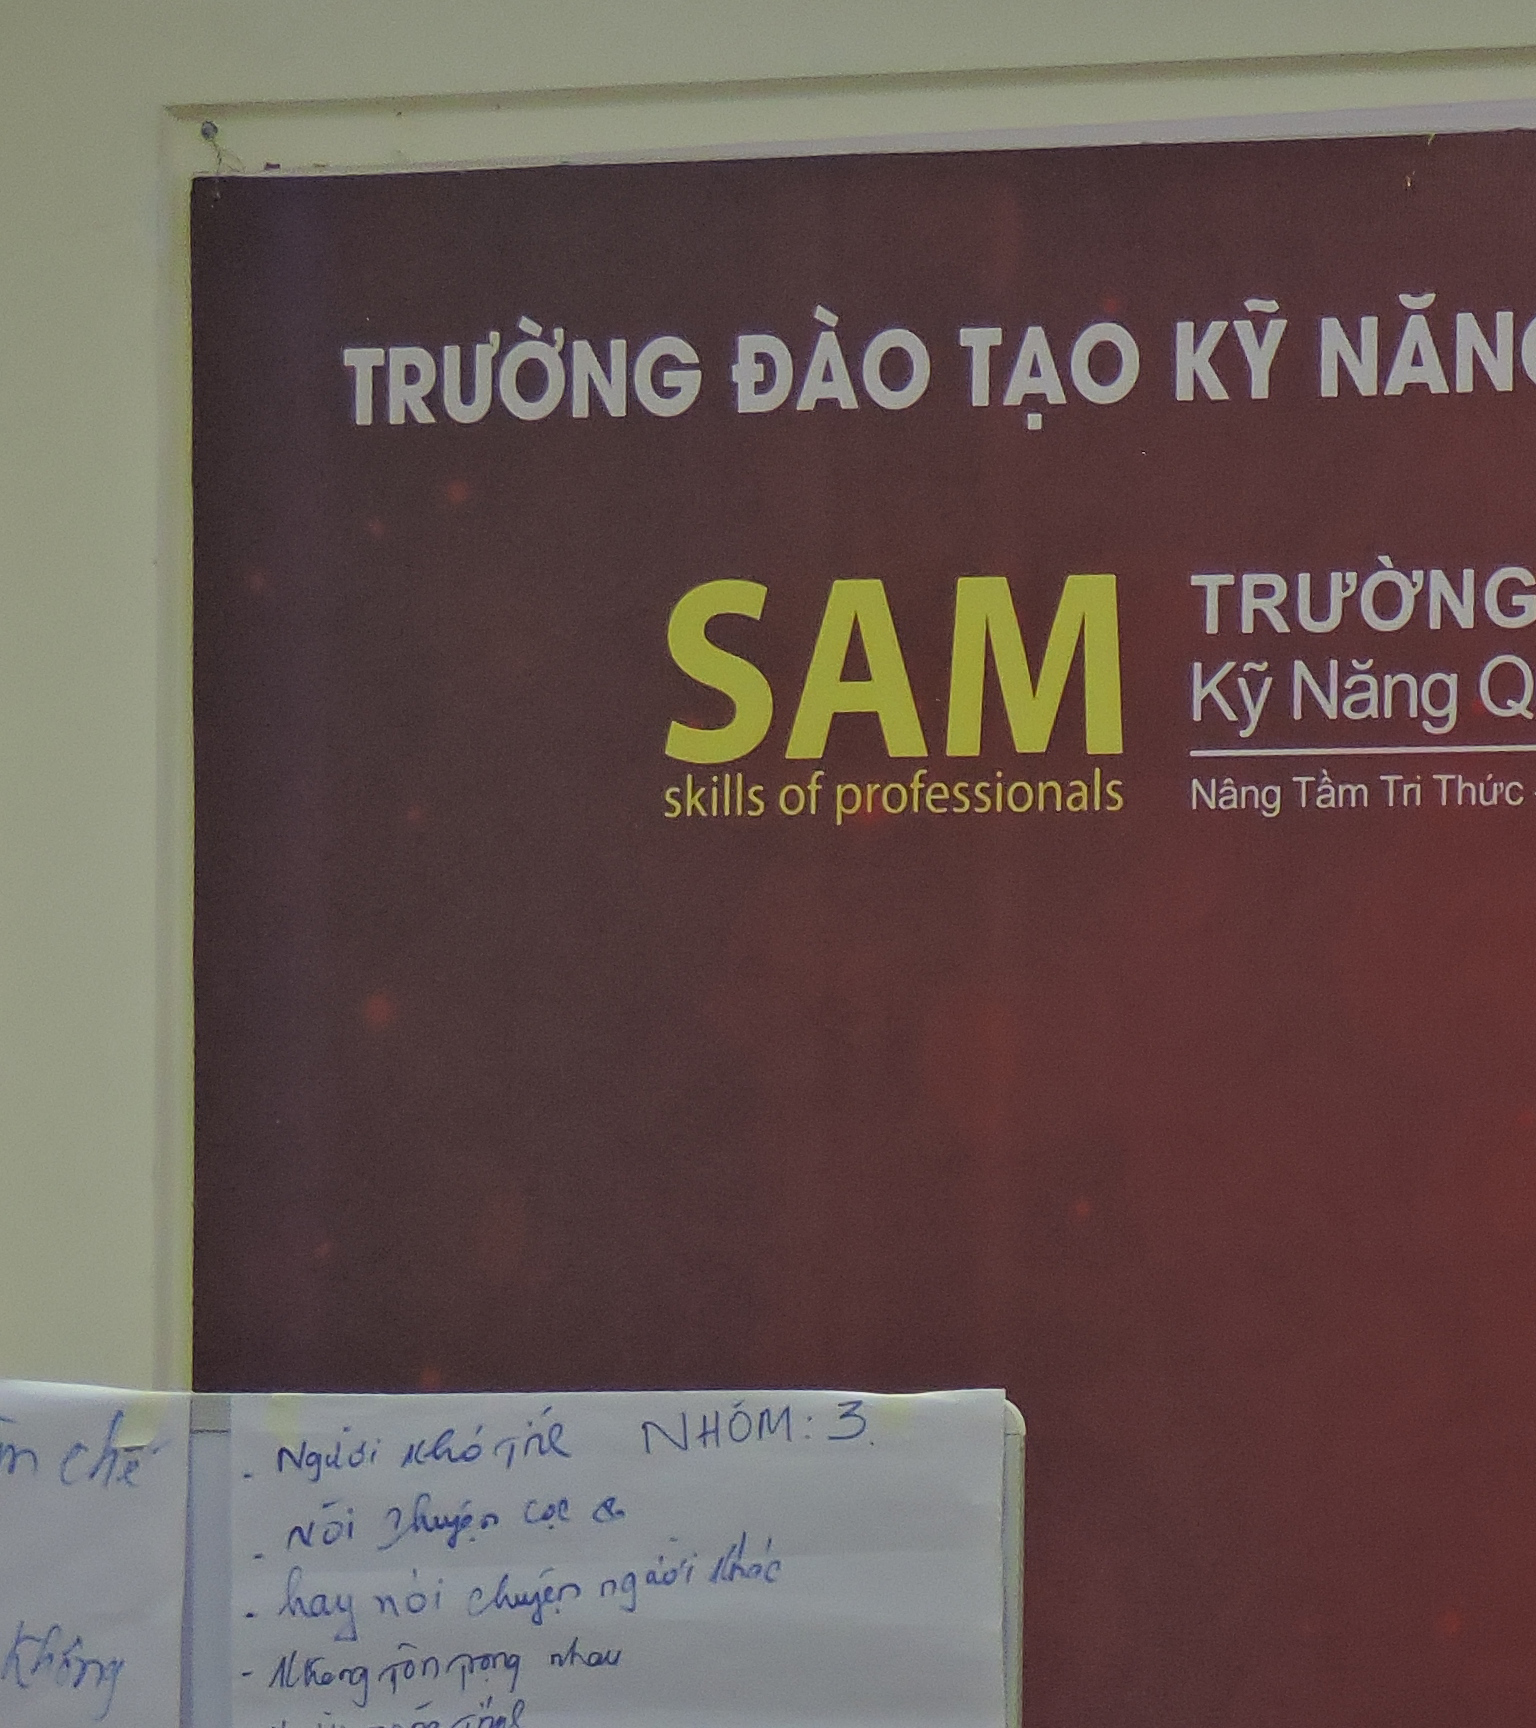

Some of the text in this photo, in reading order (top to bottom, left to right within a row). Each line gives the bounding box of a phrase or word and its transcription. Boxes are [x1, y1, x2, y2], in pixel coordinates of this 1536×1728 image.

[344, 315, 702, 426] TRƯỜNG
[732, 305, 931, 414] ĐÀO
[960, 322, 1140, 430] TẠO
[1176, 298, 1288, 401] KỸ
[664, 574, 1124, 764] SAM
[1192, 661, 1273, 738] Kỹ
[1293, 658, 1458, 735] Năng
[664, 765, 1124, 826] skills of professionals
[1192, 774, 1281, 818] Nâng
[1292, 769, 1368, 811] Tầm
[1379, 775, 1421, 807] Tri
[1433, 773, 1524, 807] Thức
